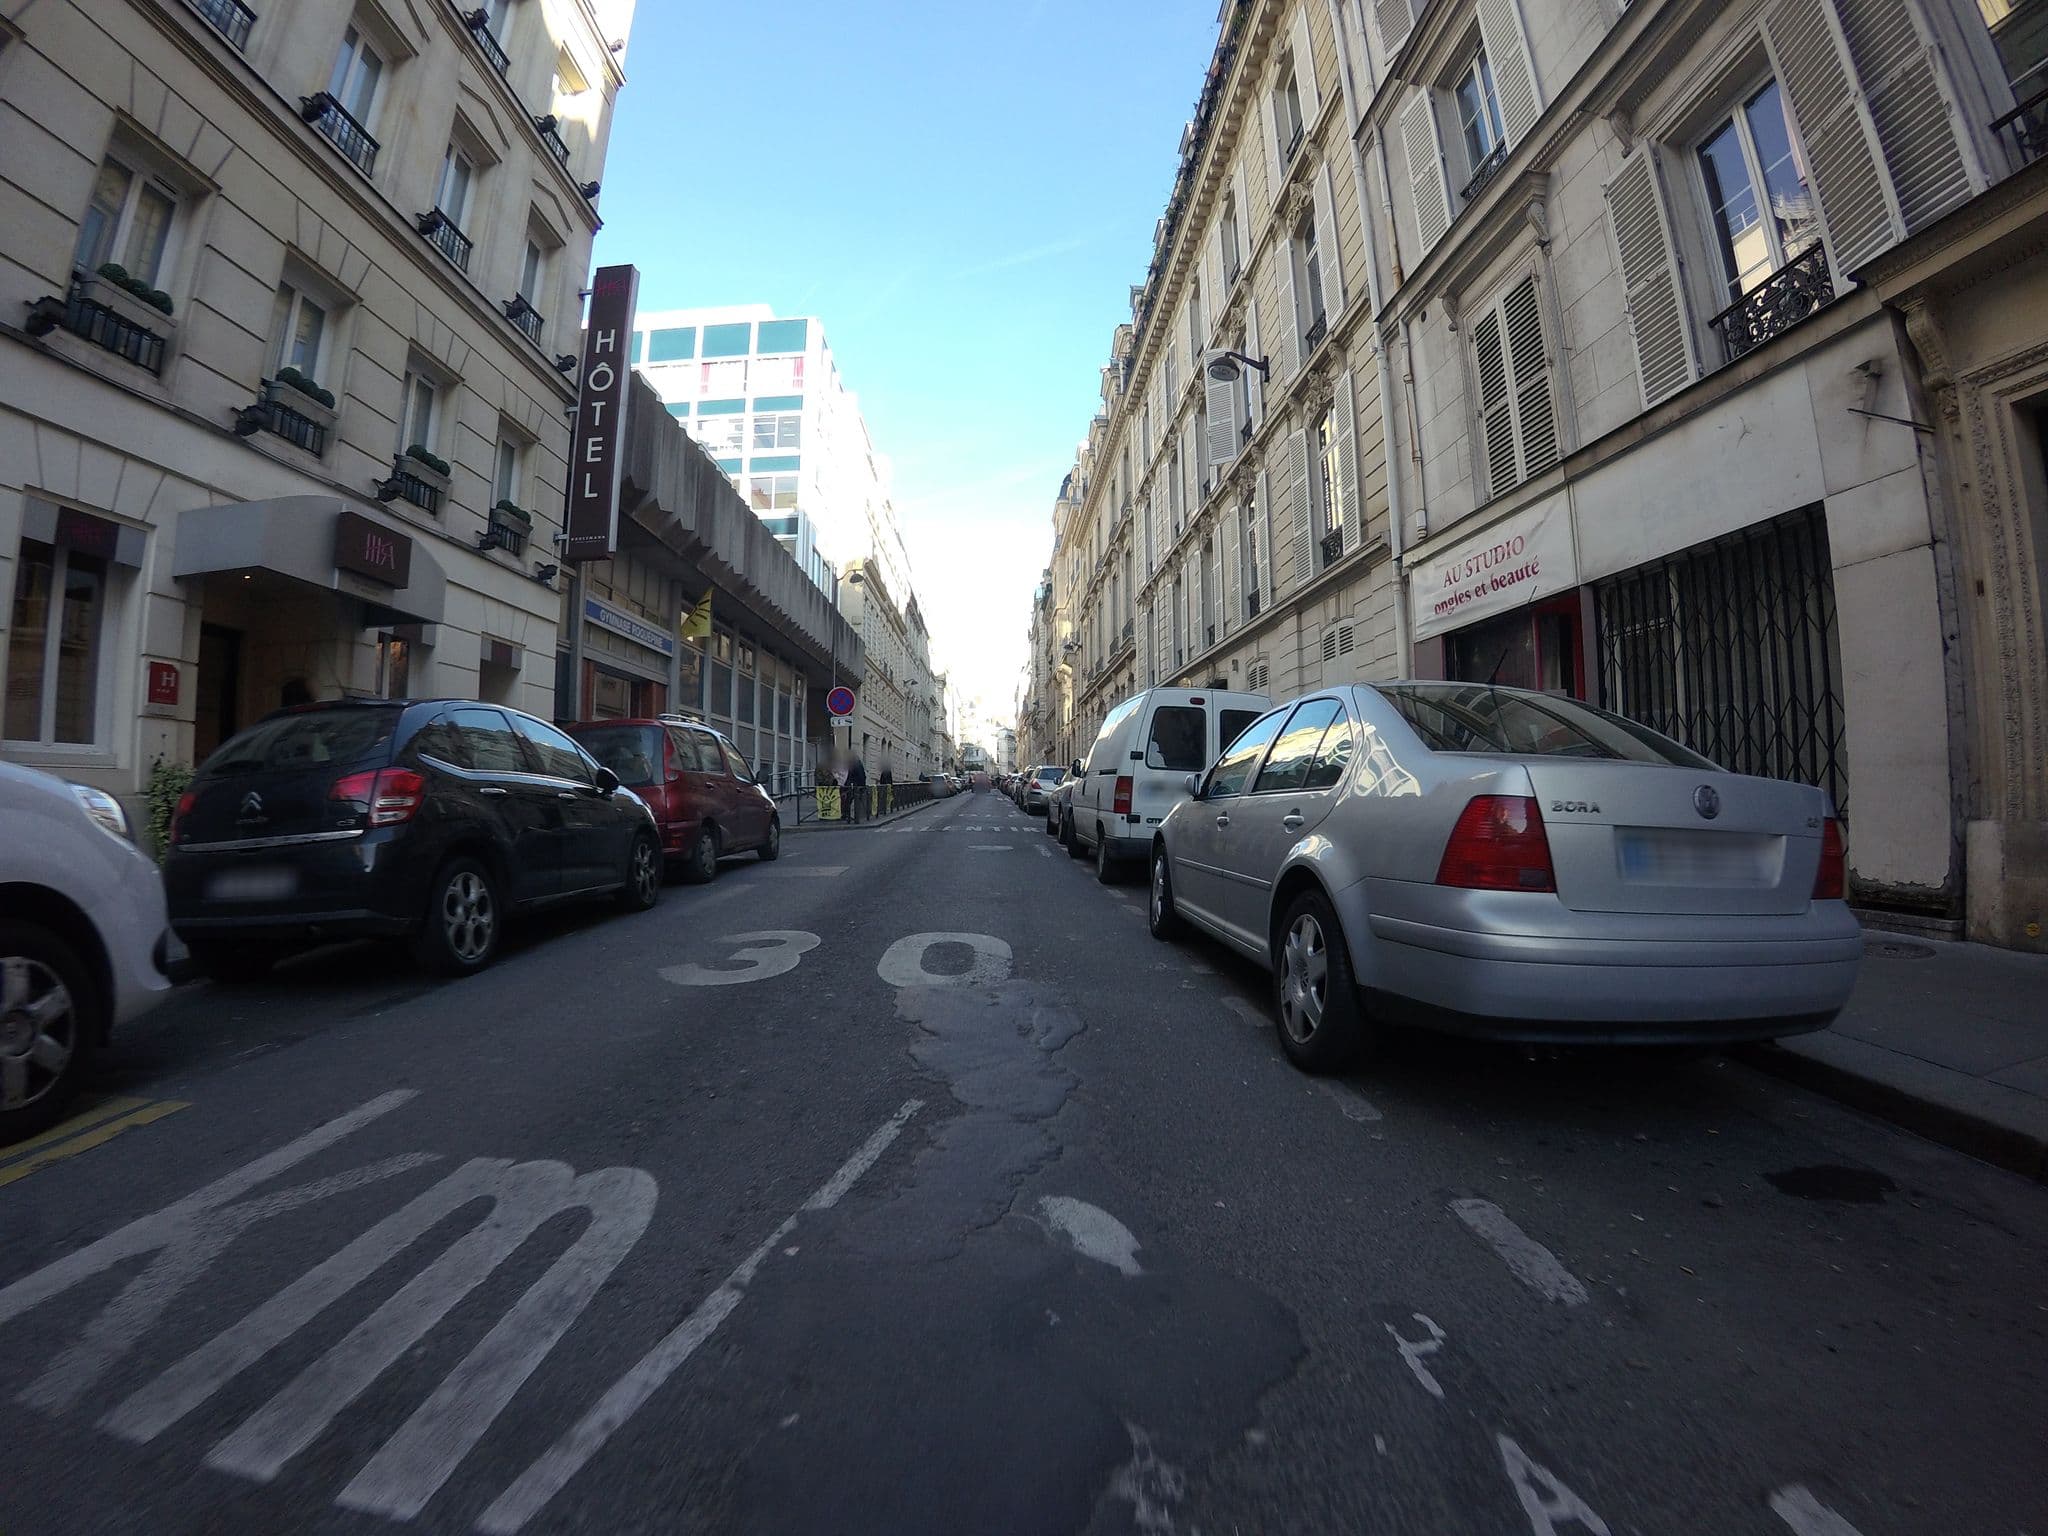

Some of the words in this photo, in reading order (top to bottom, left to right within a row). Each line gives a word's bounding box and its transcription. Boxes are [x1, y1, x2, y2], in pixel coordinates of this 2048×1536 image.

[584, 328, 616, 498] HÔTEL
[1434, 588, 1472, 615] ongles
[1474, 579, 1488, 598] et
[1490, 554, 1541, 592] beauté
[1443, 564, 1462, 588] AU
[1465, 535, 1525, 578] STUDIO
[161, 671, 176, 687] H
[1551, 799, 1601, 814] BORA
